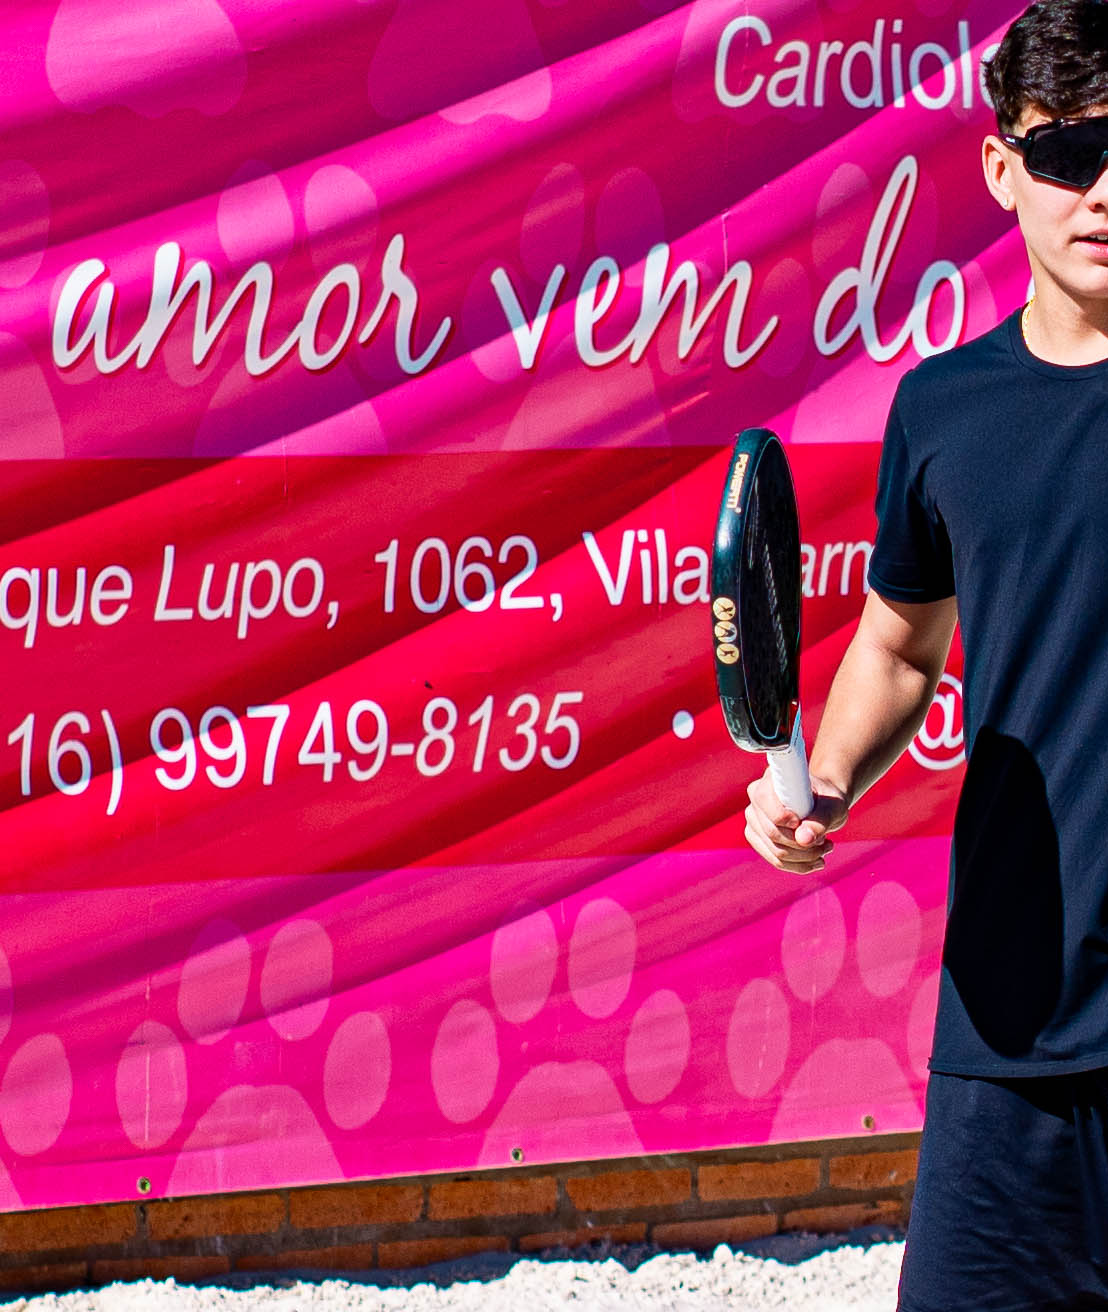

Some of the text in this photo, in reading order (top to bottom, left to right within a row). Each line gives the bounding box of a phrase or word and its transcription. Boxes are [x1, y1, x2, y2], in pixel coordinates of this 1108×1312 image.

[714, 14, 1000, 111] Cardiol
[51, 232, 453, 377] amor
[490, 241, 780, 372] vem
[812, 153, 968, 364] do
[153, 544, 340, 640] Lupo,
[373, 534, 564, 623] 1062,
[581, 527, 710, 606] Vila
[149, 691, 584, 792] 99749-8135
